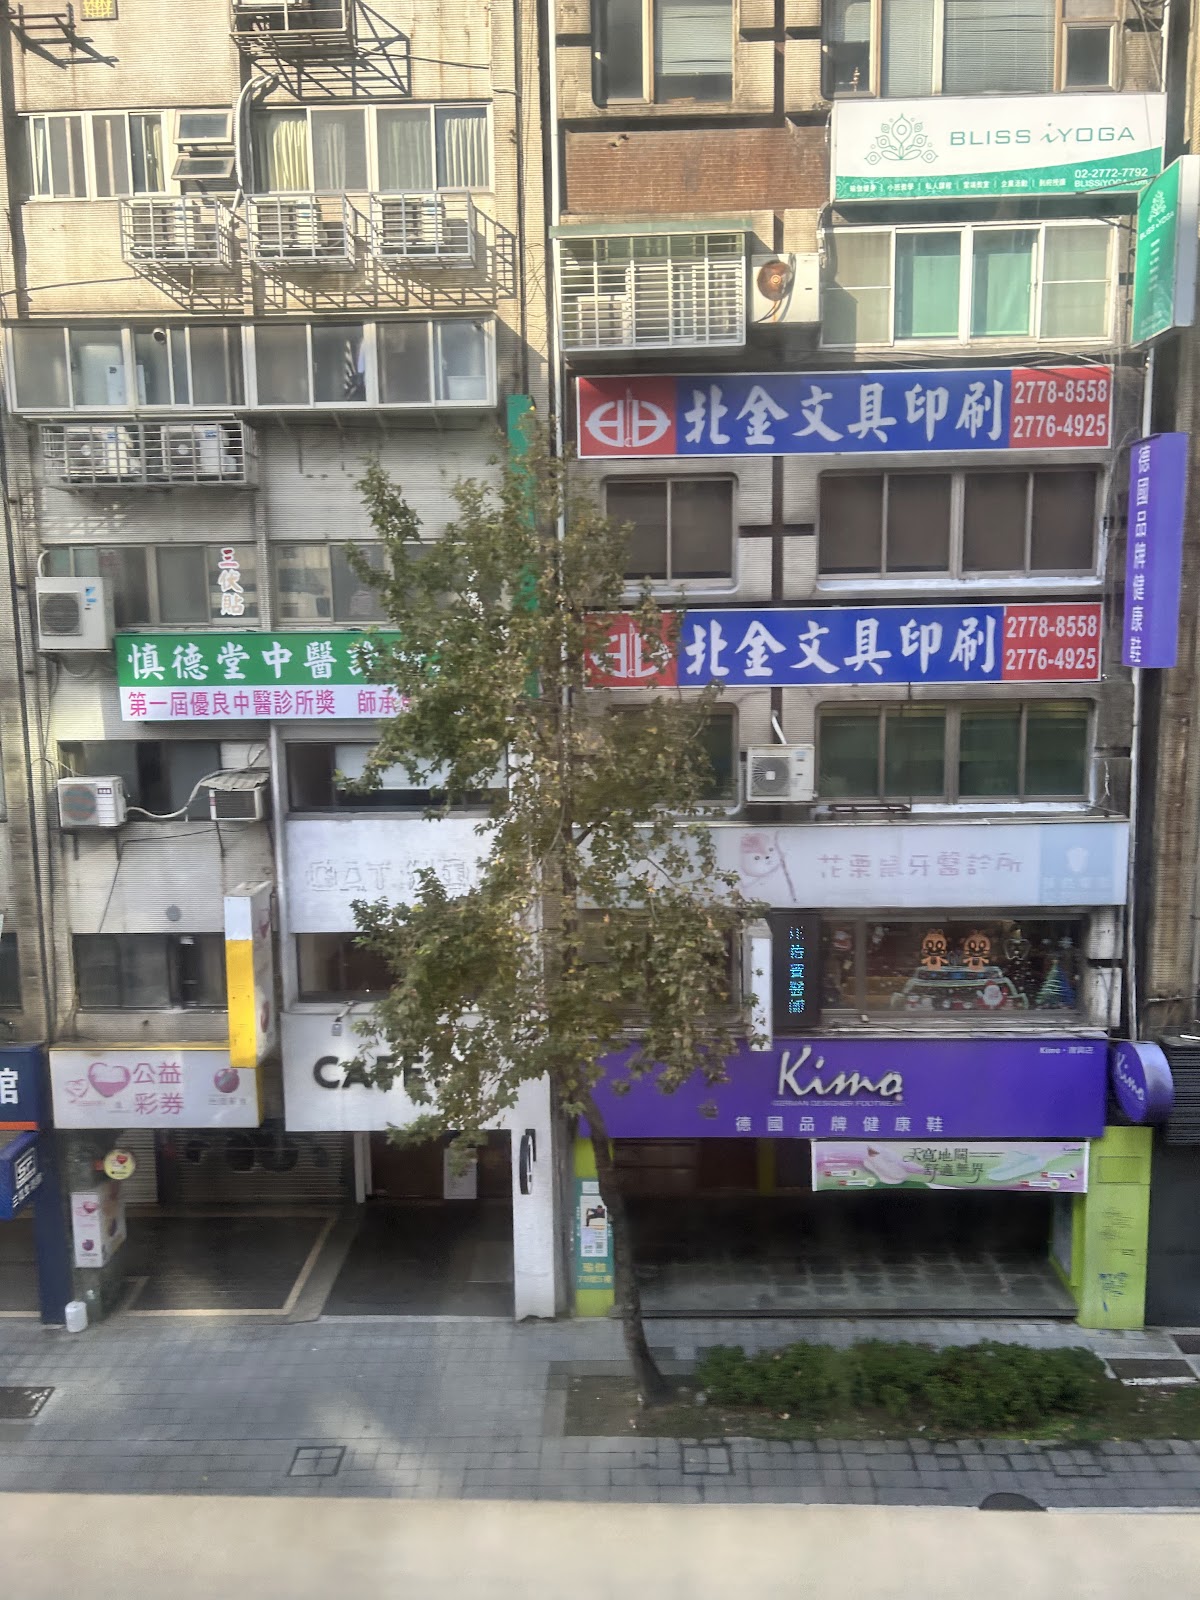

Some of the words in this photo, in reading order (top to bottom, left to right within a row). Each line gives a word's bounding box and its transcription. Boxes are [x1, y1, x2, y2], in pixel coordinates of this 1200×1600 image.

[949, 129, 1032, 146] BLISS
[1039, 122, 1136, 144] iYOGA
[1074, 167, 1149, 178] 02-2772-7792
[1014, 379, 1108, 405] 2778-8558
[684, 379, 1003, 446] 北金文具印刷
[1014, 412, 1107, 440] 2776-4925
[1006, 613, 1098, 639] 2778-8558
[684, 614, 996, 679] 北金文具印刷
[1006, 647, 1097, 671] 2776-4925
[128, 690, 336, 717] 第一屆優良中醫診所獎
[132, 1061, 182, 1085] 公益
[777, 1044, 904, 1097] Kimo
[134, 1092, 185, 1116] 彩券
[735, 1115, 945, 1133] 德國品牌健康鞋
